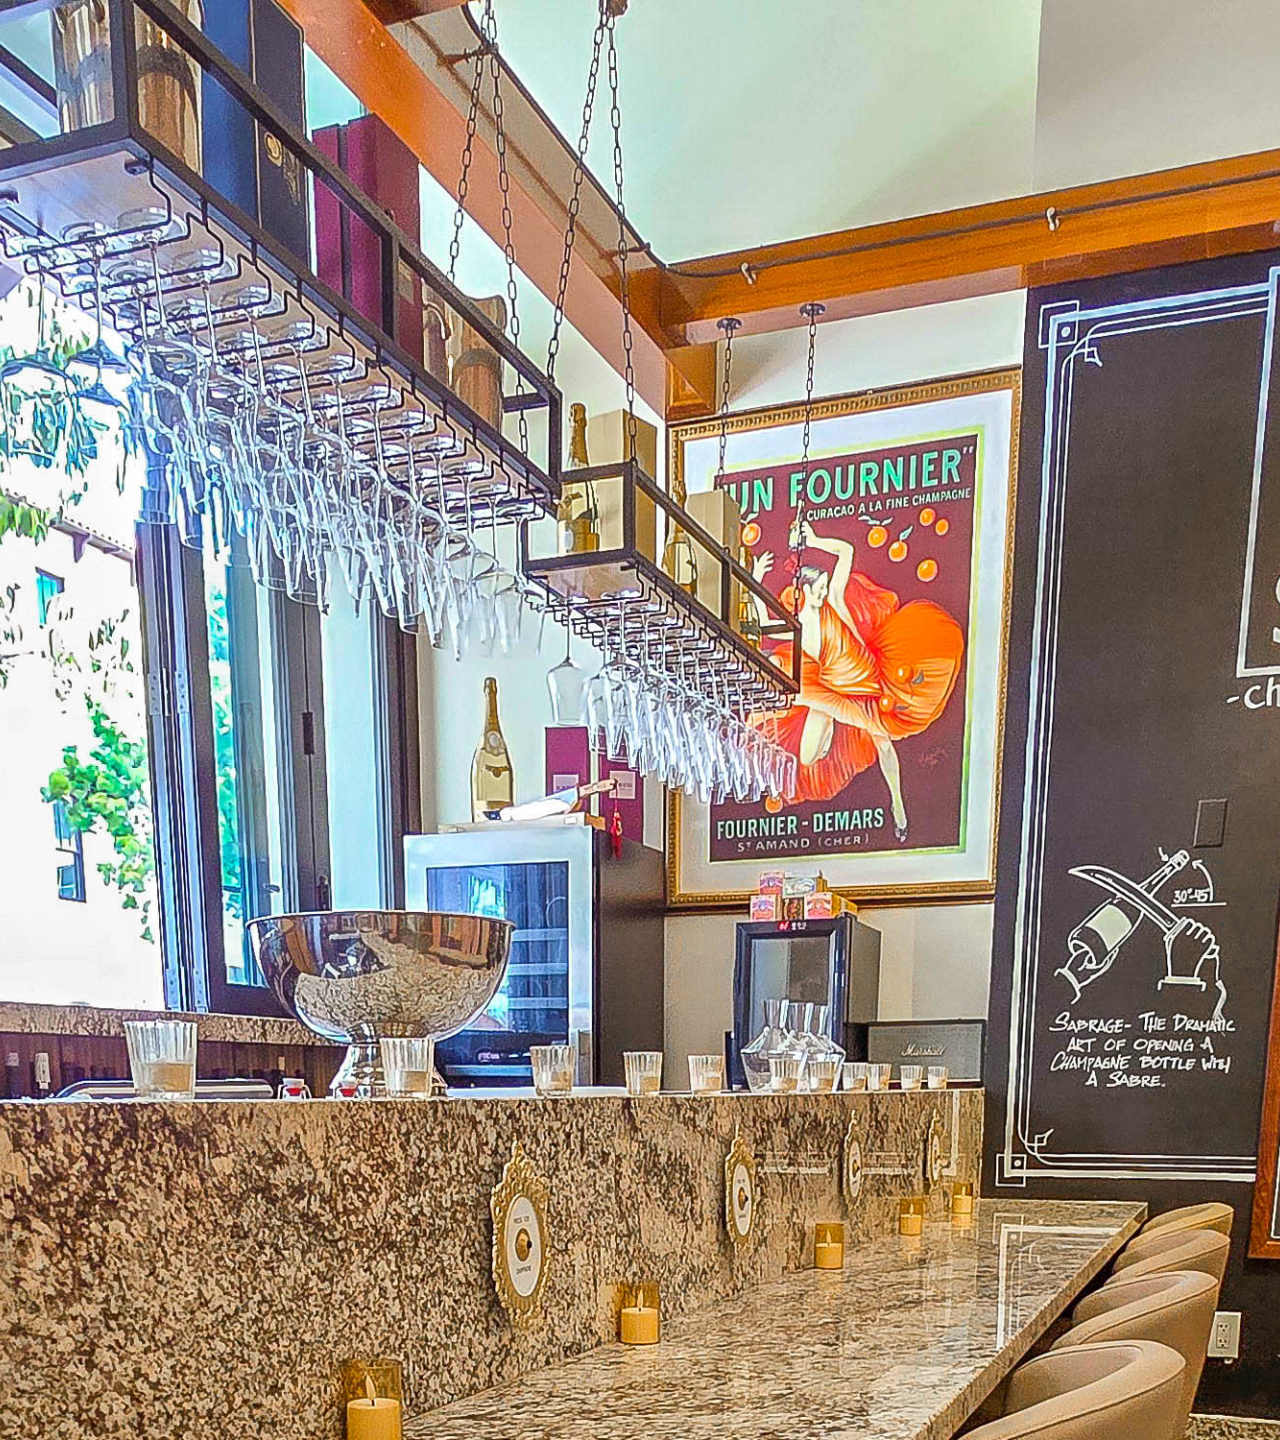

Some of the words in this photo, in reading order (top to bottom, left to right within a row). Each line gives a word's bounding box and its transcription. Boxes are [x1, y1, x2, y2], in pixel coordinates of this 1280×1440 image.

[869, 501, 882, 513] LA
[886, 497, 909, 510] FINE
[912, 488, 972, 507] CHAMPAGNE
[717, 815, 798, 840] FOURNIER
[813, 807, 885, 834] DEMARS
[755, 838, 810, 851] AMAND
[817, 833, 869, 847] (CHER)
[1138, 1011, 1167, 1032] THE
[1172, 1014, 1236, 1033] DRAMATIC
[1066, 1036, 1097, 1053] ART
[1103, 1038, 1127, 1051] OF
[1133, 1038, 1194, 1054] OPENING
[1200, 1036, 1214, 1054] A
[1050, 1051, 1132, 1072] CHAMPAGNE
[1139, 1056, 1196, 1071] BOTTLE
[1201, 1055, 1231, 1074] WITH
[1085, 1071, 1098, 1087] A
[1106, 1071, 1167, 1088] SABRE.
